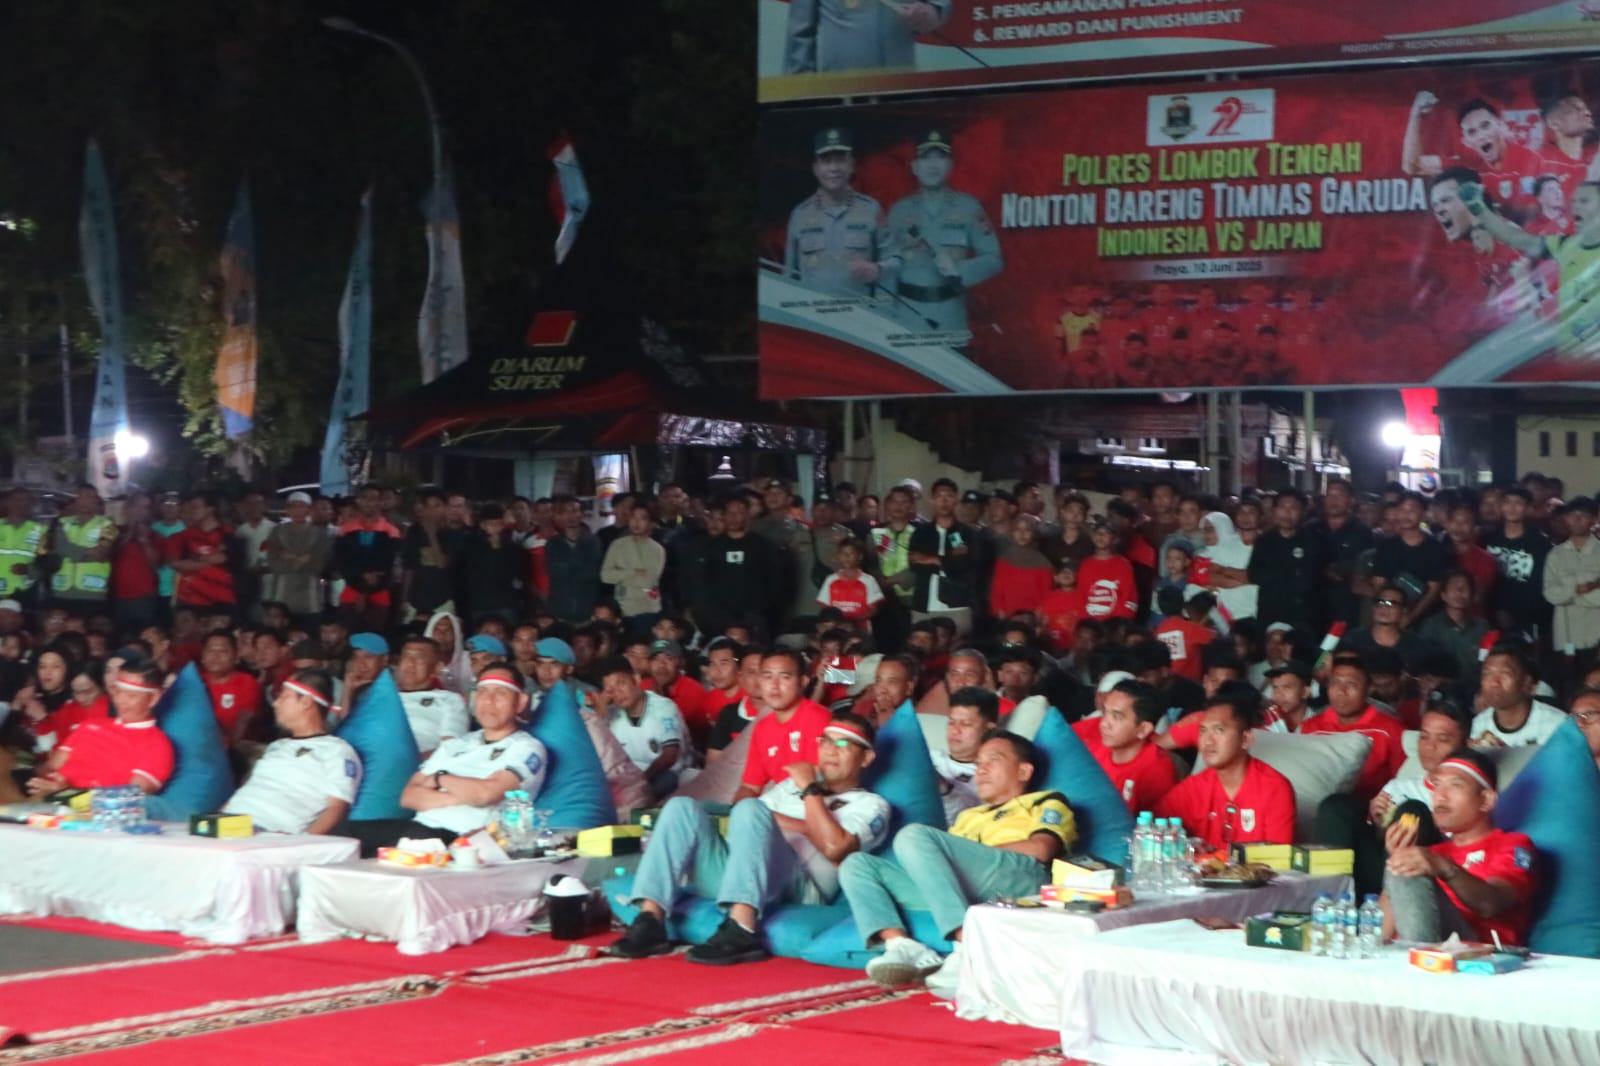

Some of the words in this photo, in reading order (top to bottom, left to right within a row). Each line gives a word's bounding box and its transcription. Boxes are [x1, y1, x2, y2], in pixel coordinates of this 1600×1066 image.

[992, 0, 1125, 18] PENGAMANAN
[993, 21, 1073, 40] REWARD
[1076, 18, 1118, 34] DAN
[1121, 9, 1244, 31] PUNISHMENT
[1062, 153, 1152, 186] POLRES
[1158, 147, 1259, 182] LOMBOK
[1265, 141, 1362, 176] TENGAH
[1001, 192, 1097, 228] NONTON
[1104, 187, 1204, 223] BARENG
[1211, 182, 1313, 219] TIMNAS
[1320, 177, 1429, 214] GARUDA
[1096, 225, 1210, 256] INDONESIA
[1215, 220, 1245, 252] VS
[1249, 219, 1324, 250] JAPAN
[1210, 260, 1233, 273] Juni
[489, 374, 565, 391] SUPER
